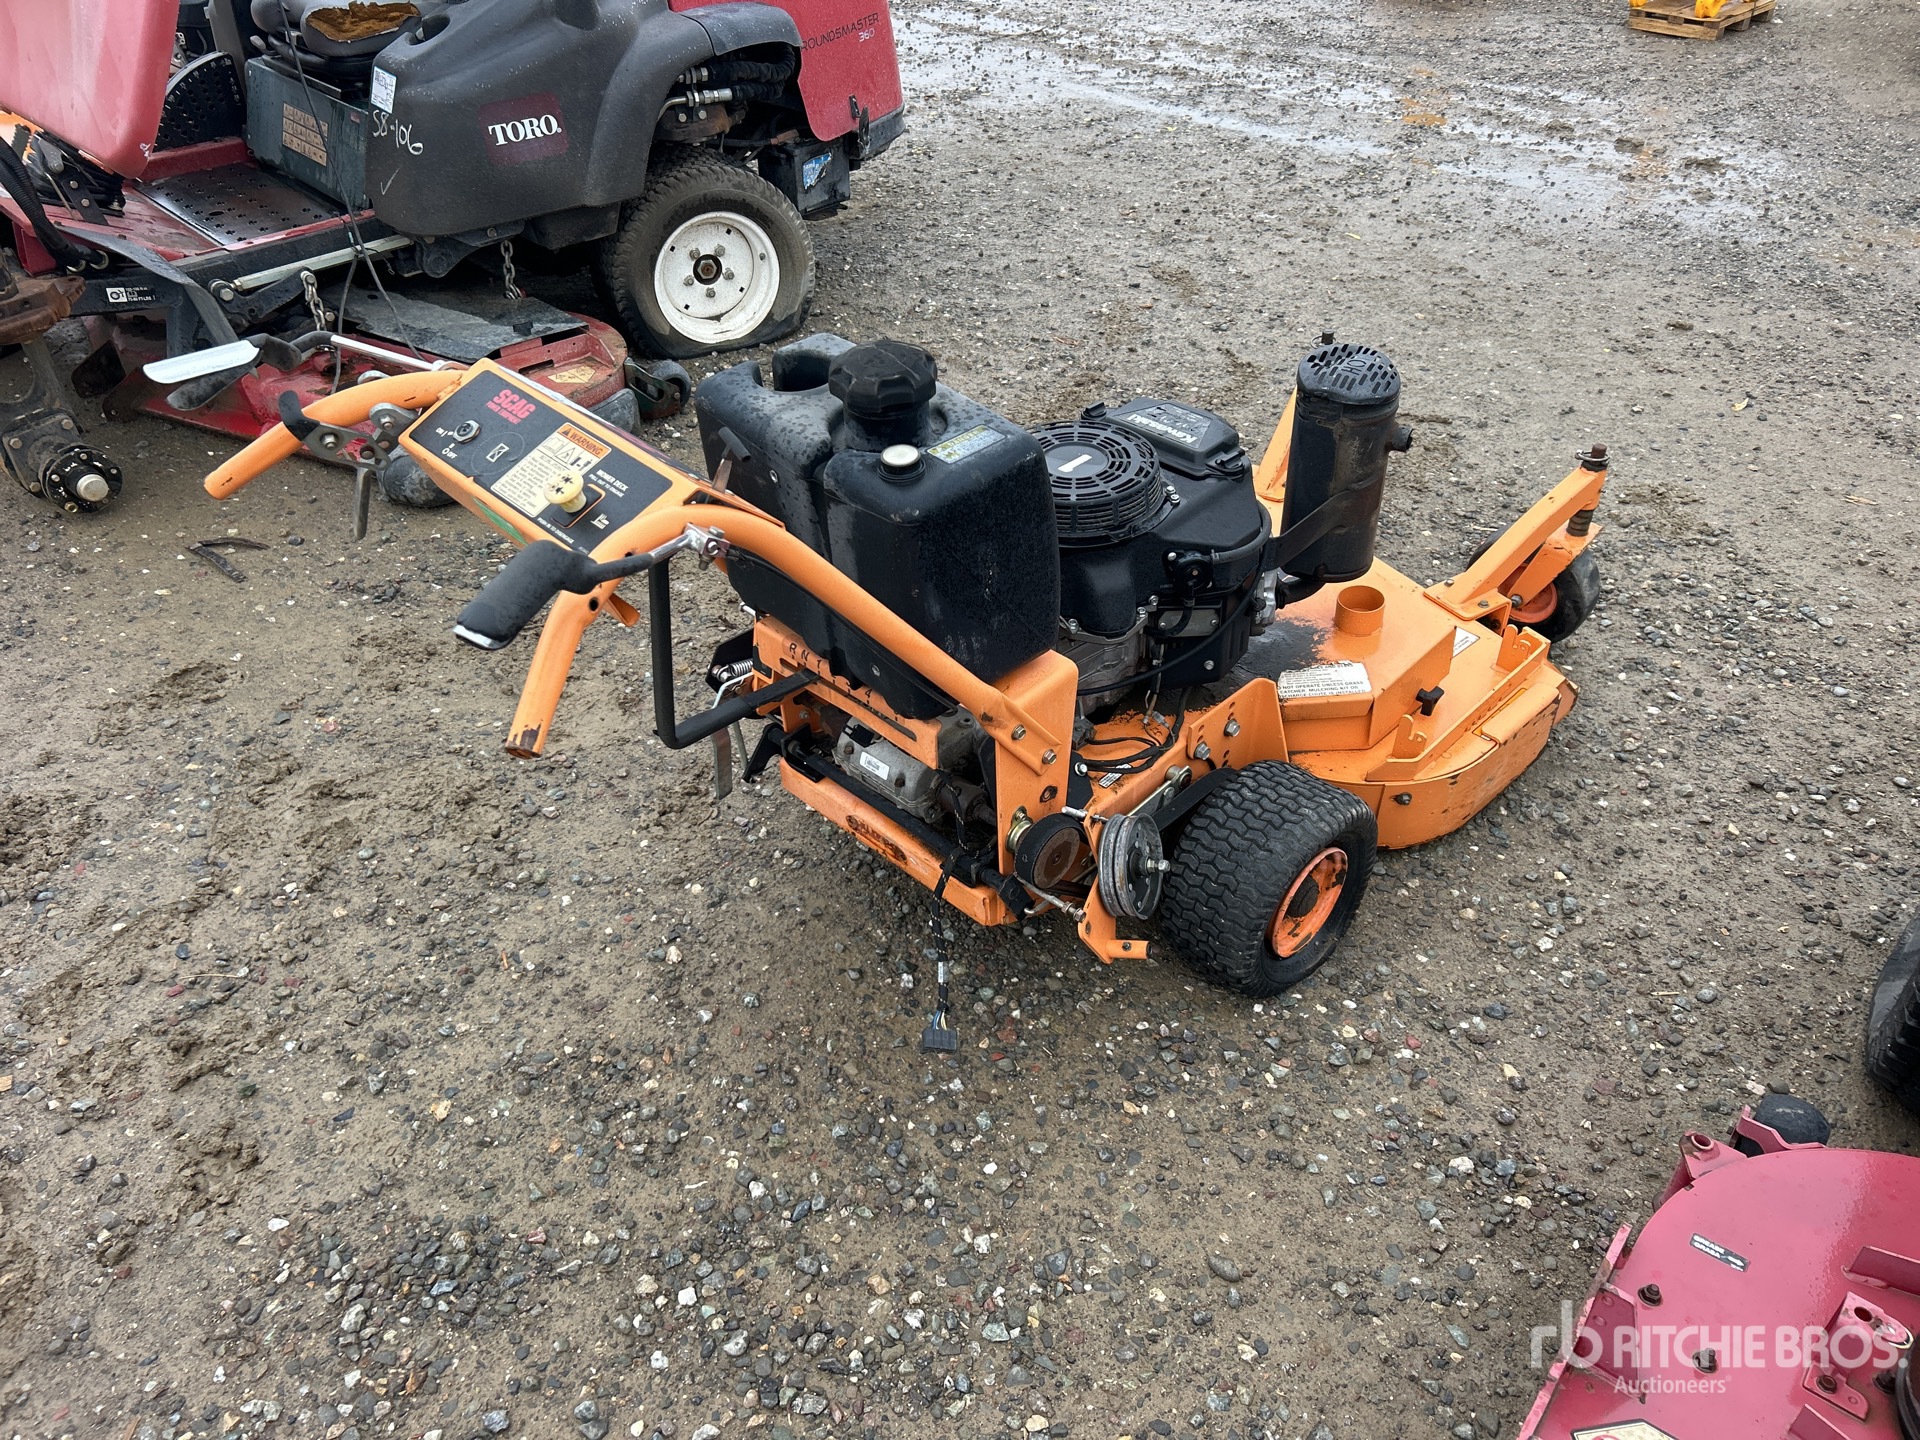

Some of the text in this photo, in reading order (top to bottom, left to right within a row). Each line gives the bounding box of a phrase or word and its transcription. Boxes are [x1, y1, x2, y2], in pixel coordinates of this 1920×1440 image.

[800, 13, 879, 52] ROUNDSMASTER
[858, 28, 875, 42] 360
[493, 389, 536, 419] SCAG
[1126, 413, 1198, 444] Kawasaki
[570, 432, 604, 456] WARNING
[596, 469, 629, 492] MOWER DECK
[789, 642, 797, 655] R
[801, 649, 810, 662] N
[864, 688, 872, 698] 4
